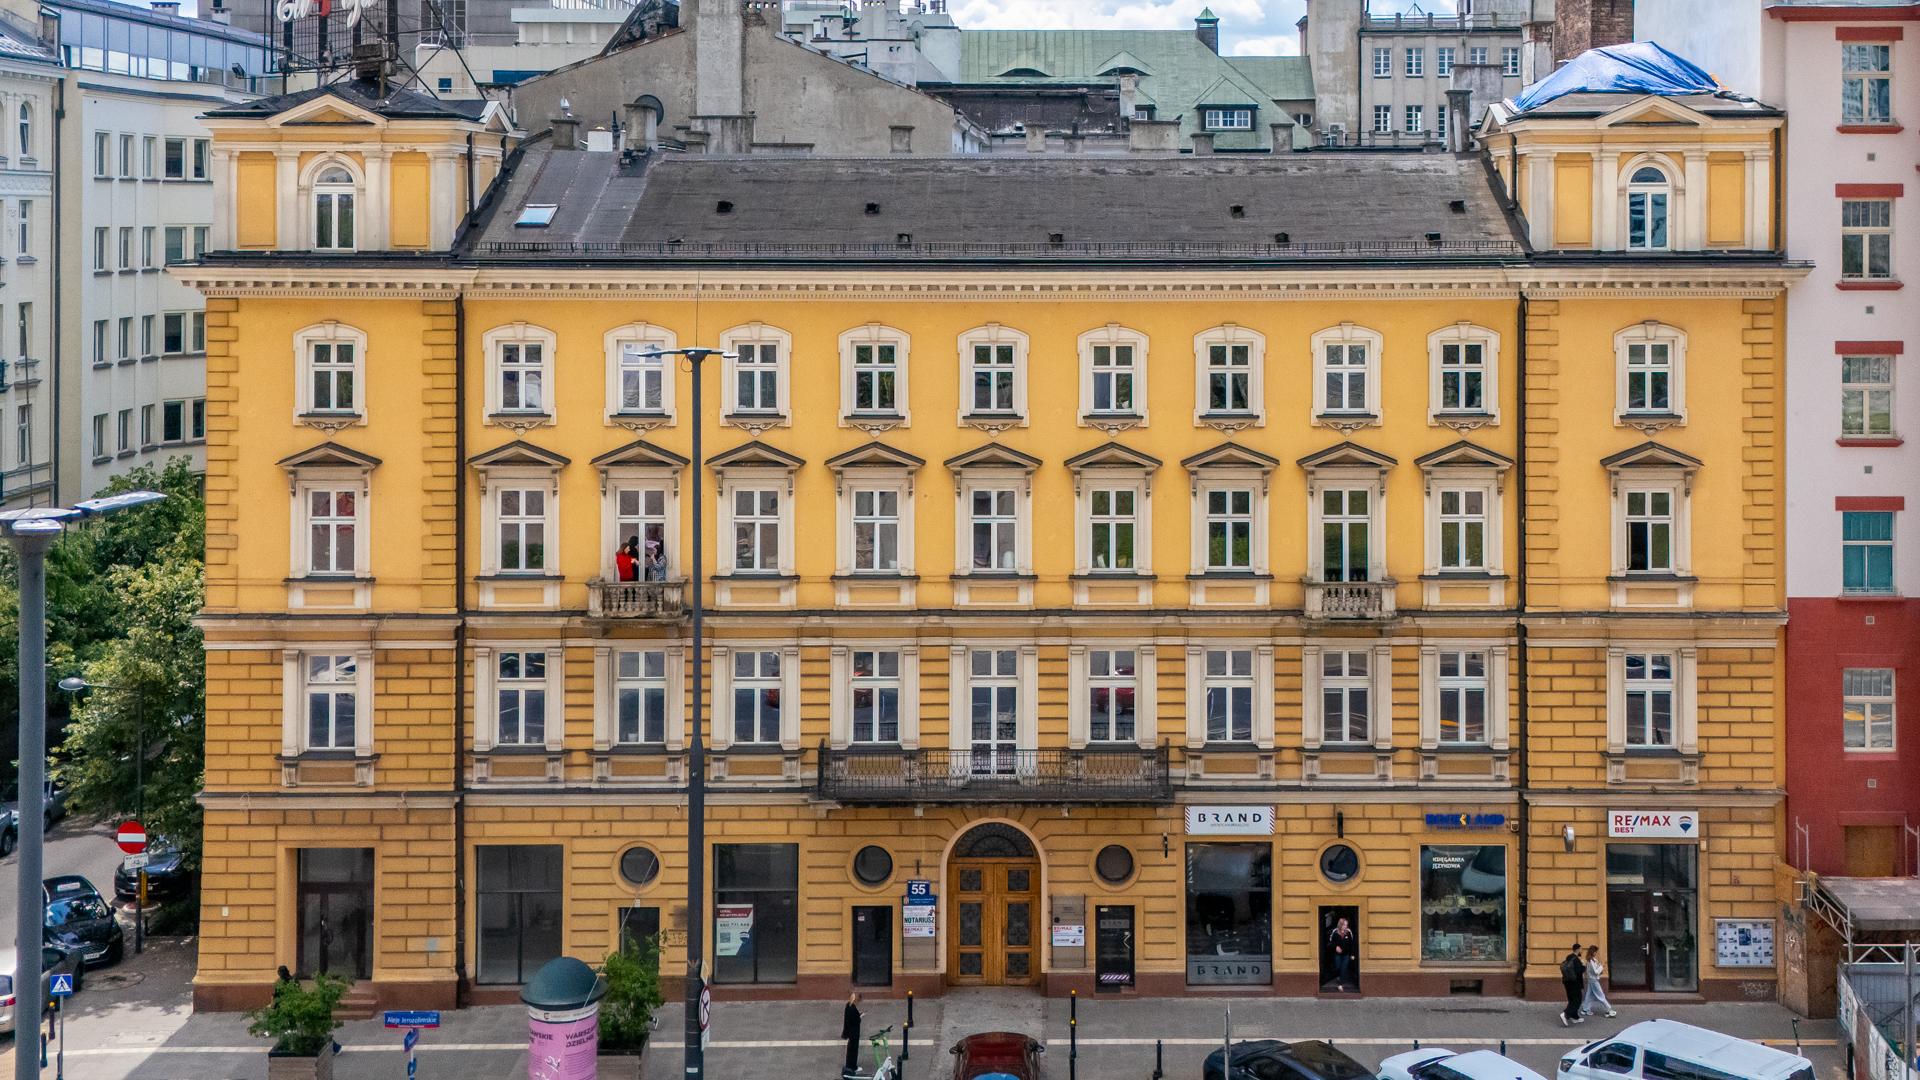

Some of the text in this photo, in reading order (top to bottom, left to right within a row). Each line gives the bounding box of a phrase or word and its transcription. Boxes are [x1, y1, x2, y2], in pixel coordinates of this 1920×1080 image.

[1198, 813, 1262, 823] BRAND
[1614, 815, 1671, 826] RE/MAX
[911, 884, 926, 895] 55
[1197, 965, 1261, 976] BRAND
